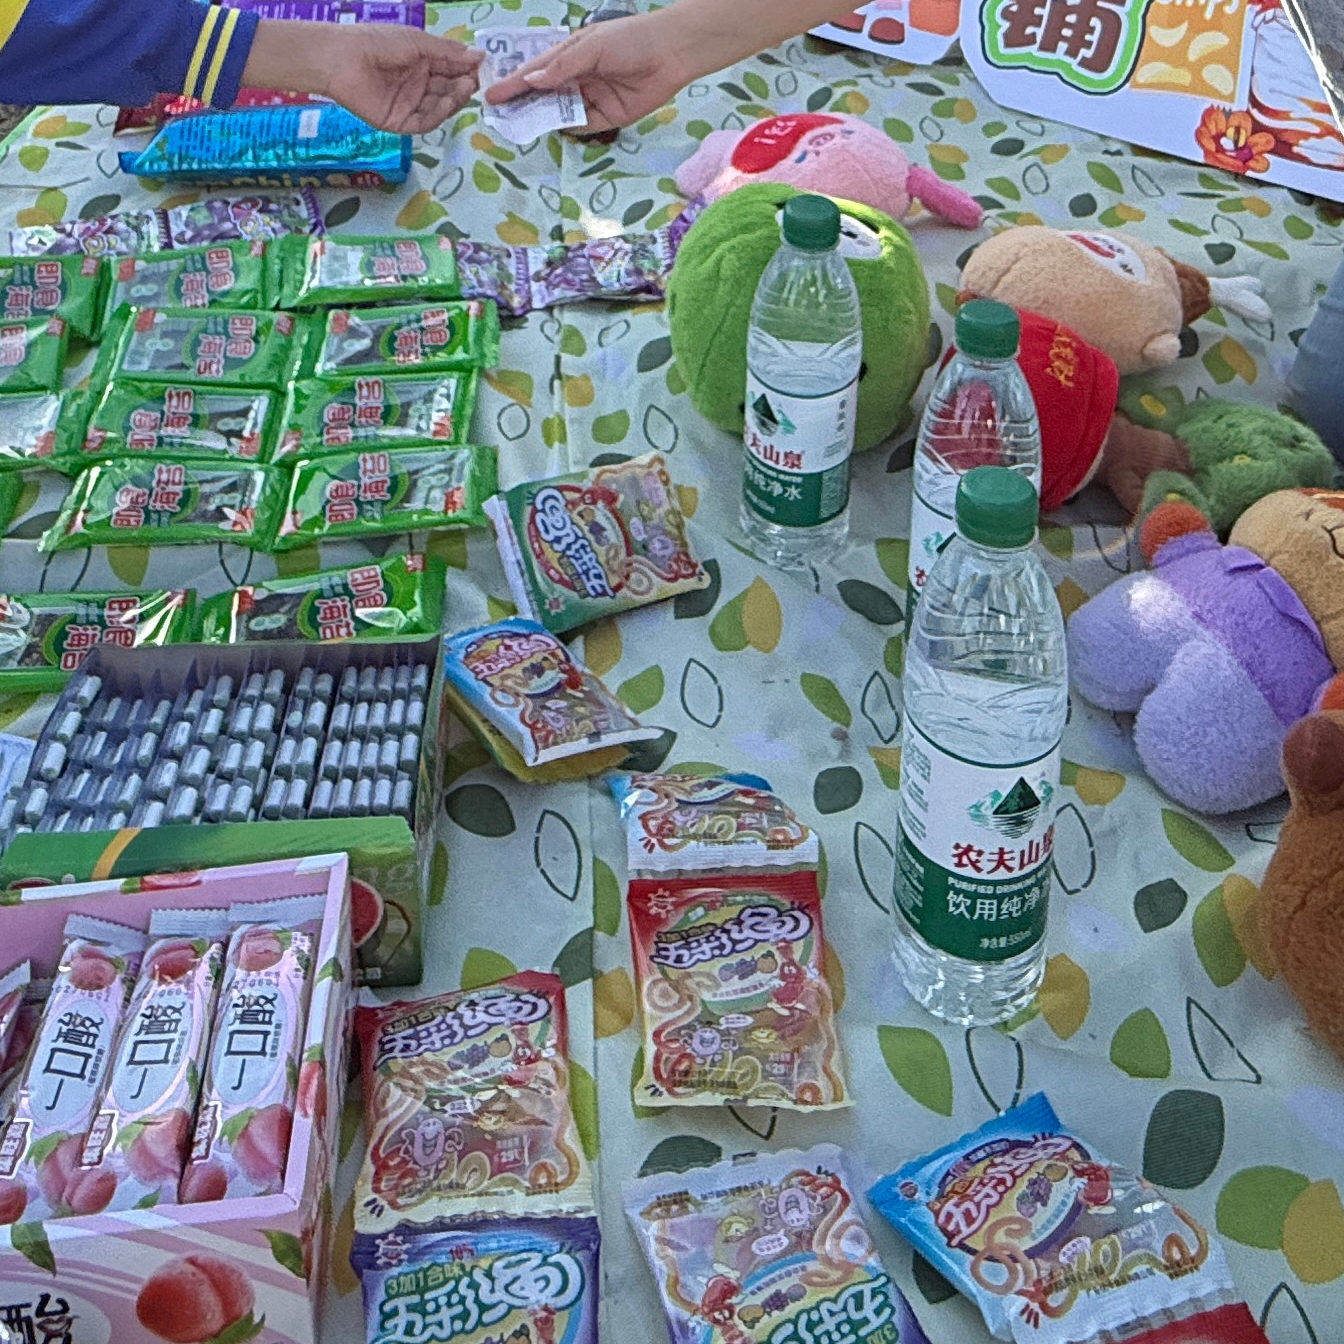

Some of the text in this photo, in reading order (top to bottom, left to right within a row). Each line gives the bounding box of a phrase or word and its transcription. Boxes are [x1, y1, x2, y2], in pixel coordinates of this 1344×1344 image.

[748, 432, 803, 470] 夫山泉
[946, 887, 1044, 922] 饮用纯净
[947, 876, 995, 895] PURIFIED
[42, 1010, 105, 1112] 一口酸
[126, 1001, 186, 1100] 一口酸
[224, 992, 278, 1091] 一口酸
